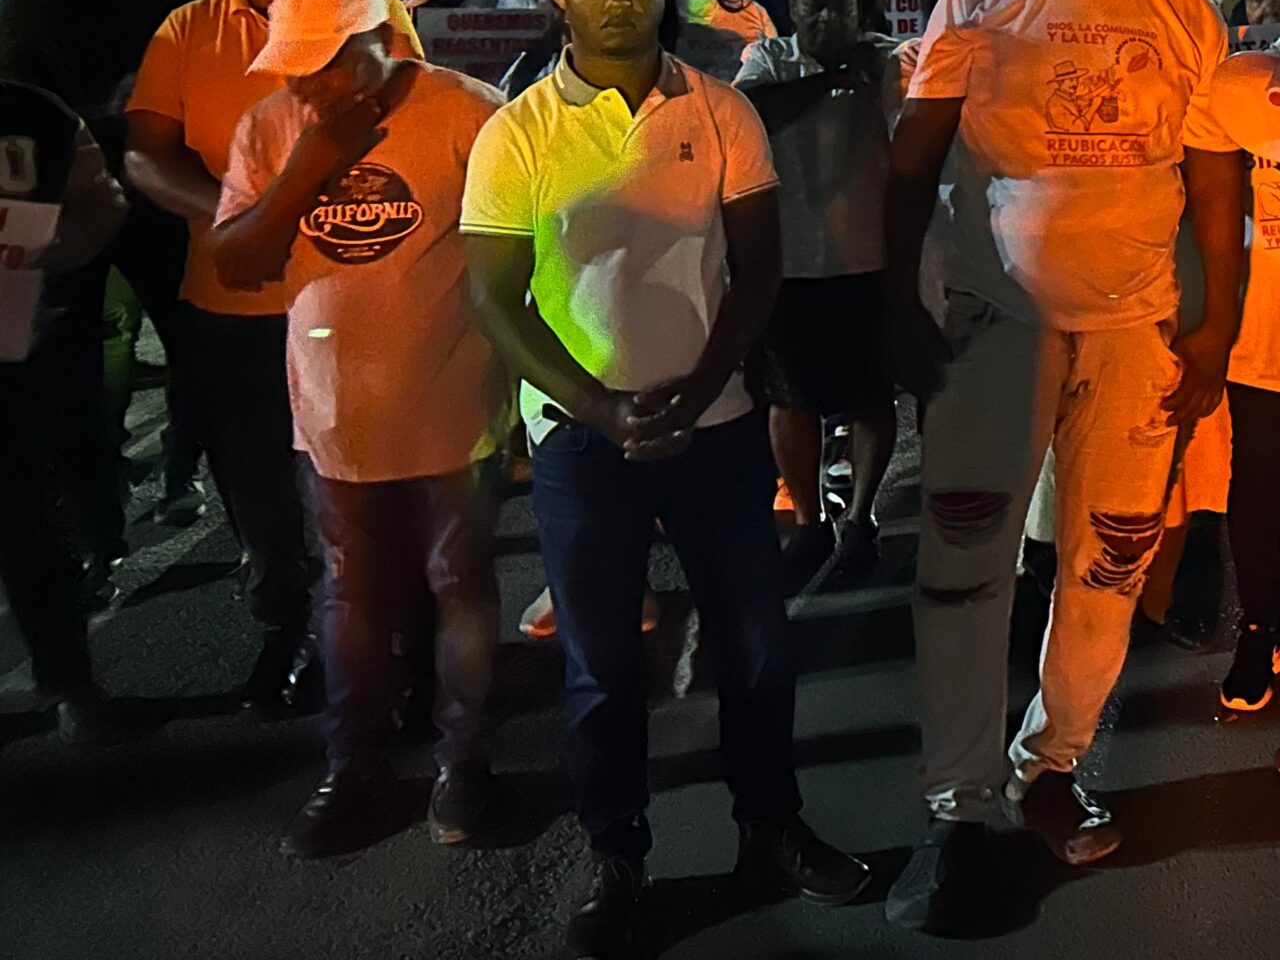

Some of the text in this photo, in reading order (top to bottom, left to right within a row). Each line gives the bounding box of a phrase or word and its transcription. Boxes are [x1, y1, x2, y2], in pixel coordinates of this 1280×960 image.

[1047, 31, 1109, 45] Y LA LEY
[1078, 23, 1091, 33] LA
[1094, 24, 1158, 40] COMUNIDAD
[1049, 153, 1061, 164] Y
[1063, 153, 1107, 165] PAGOS
[1266, 238, 1273, 247] Y
